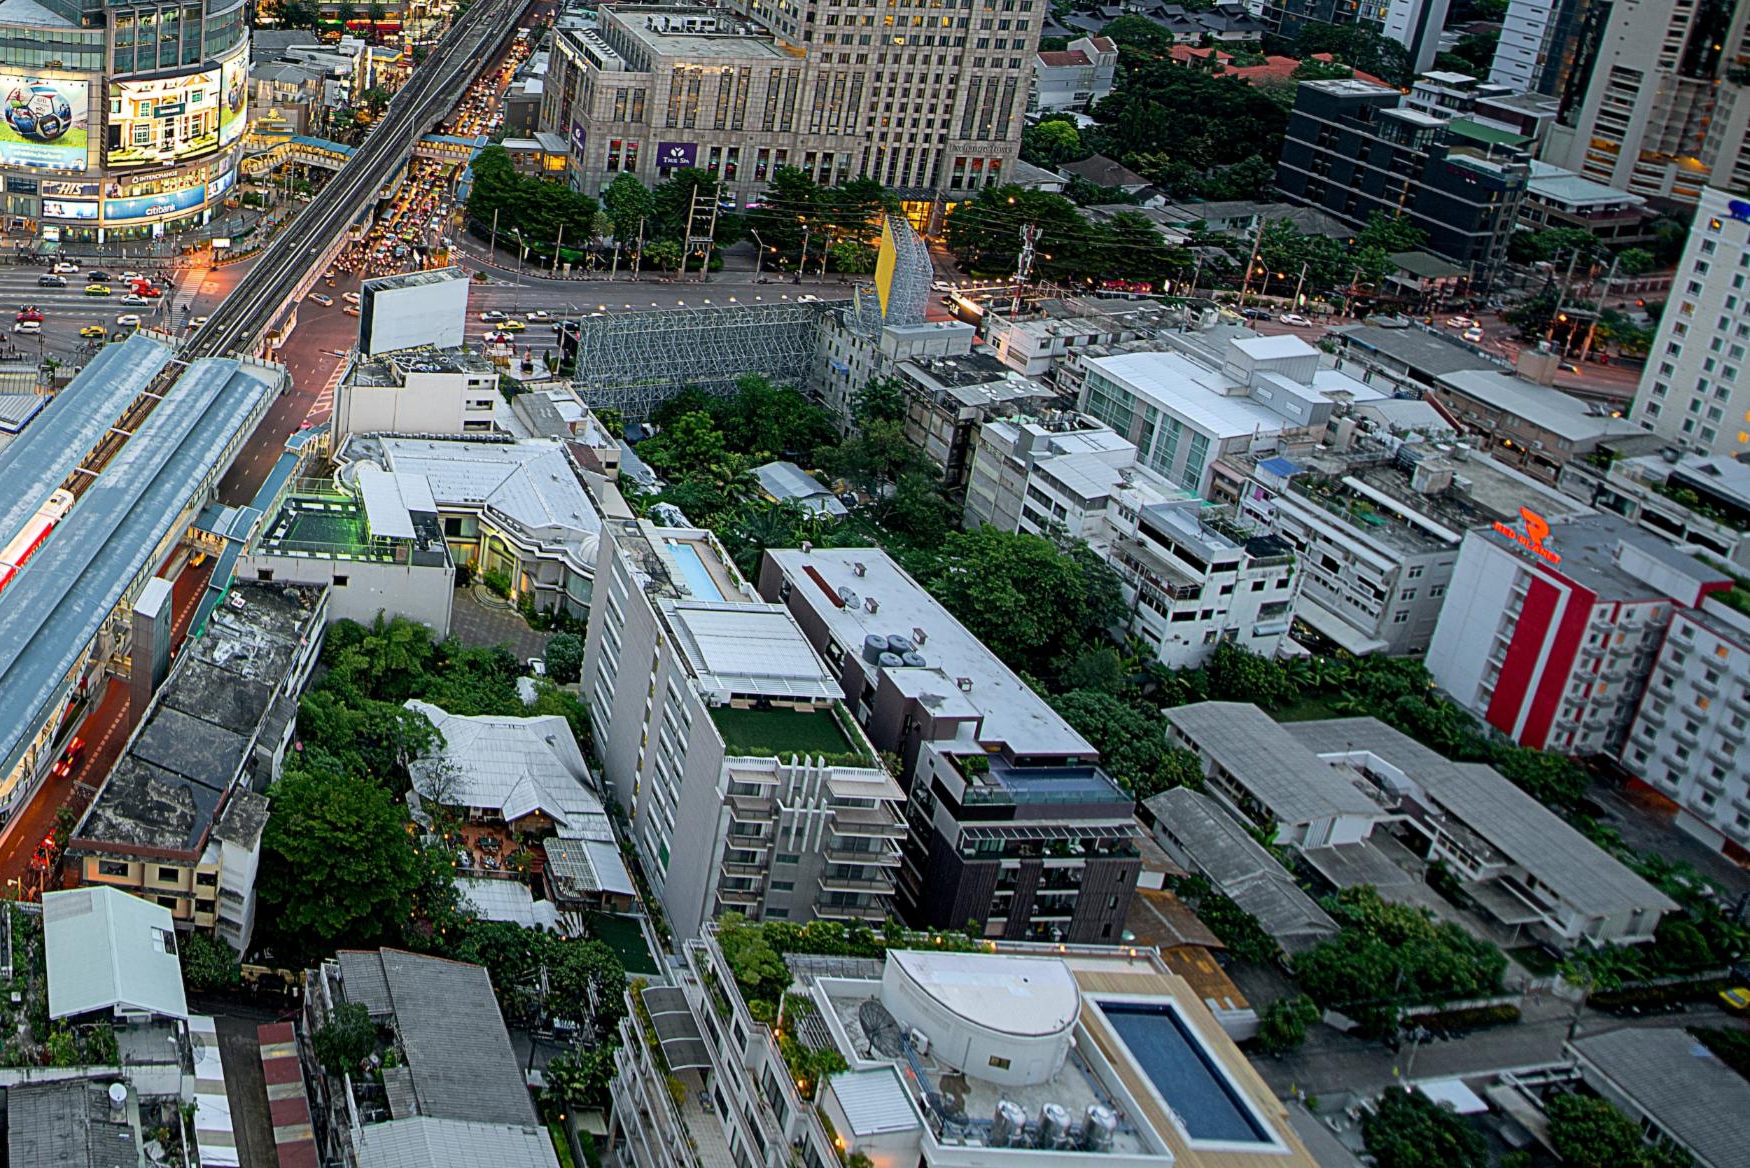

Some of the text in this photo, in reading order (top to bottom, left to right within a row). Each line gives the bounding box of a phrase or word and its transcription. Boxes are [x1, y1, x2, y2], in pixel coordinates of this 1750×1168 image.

[139, 171, 178, 183] INTERCHANGE
[145, 203, 176, 216] citibank
[1492, 519, 1562, 565] RED PLANET
